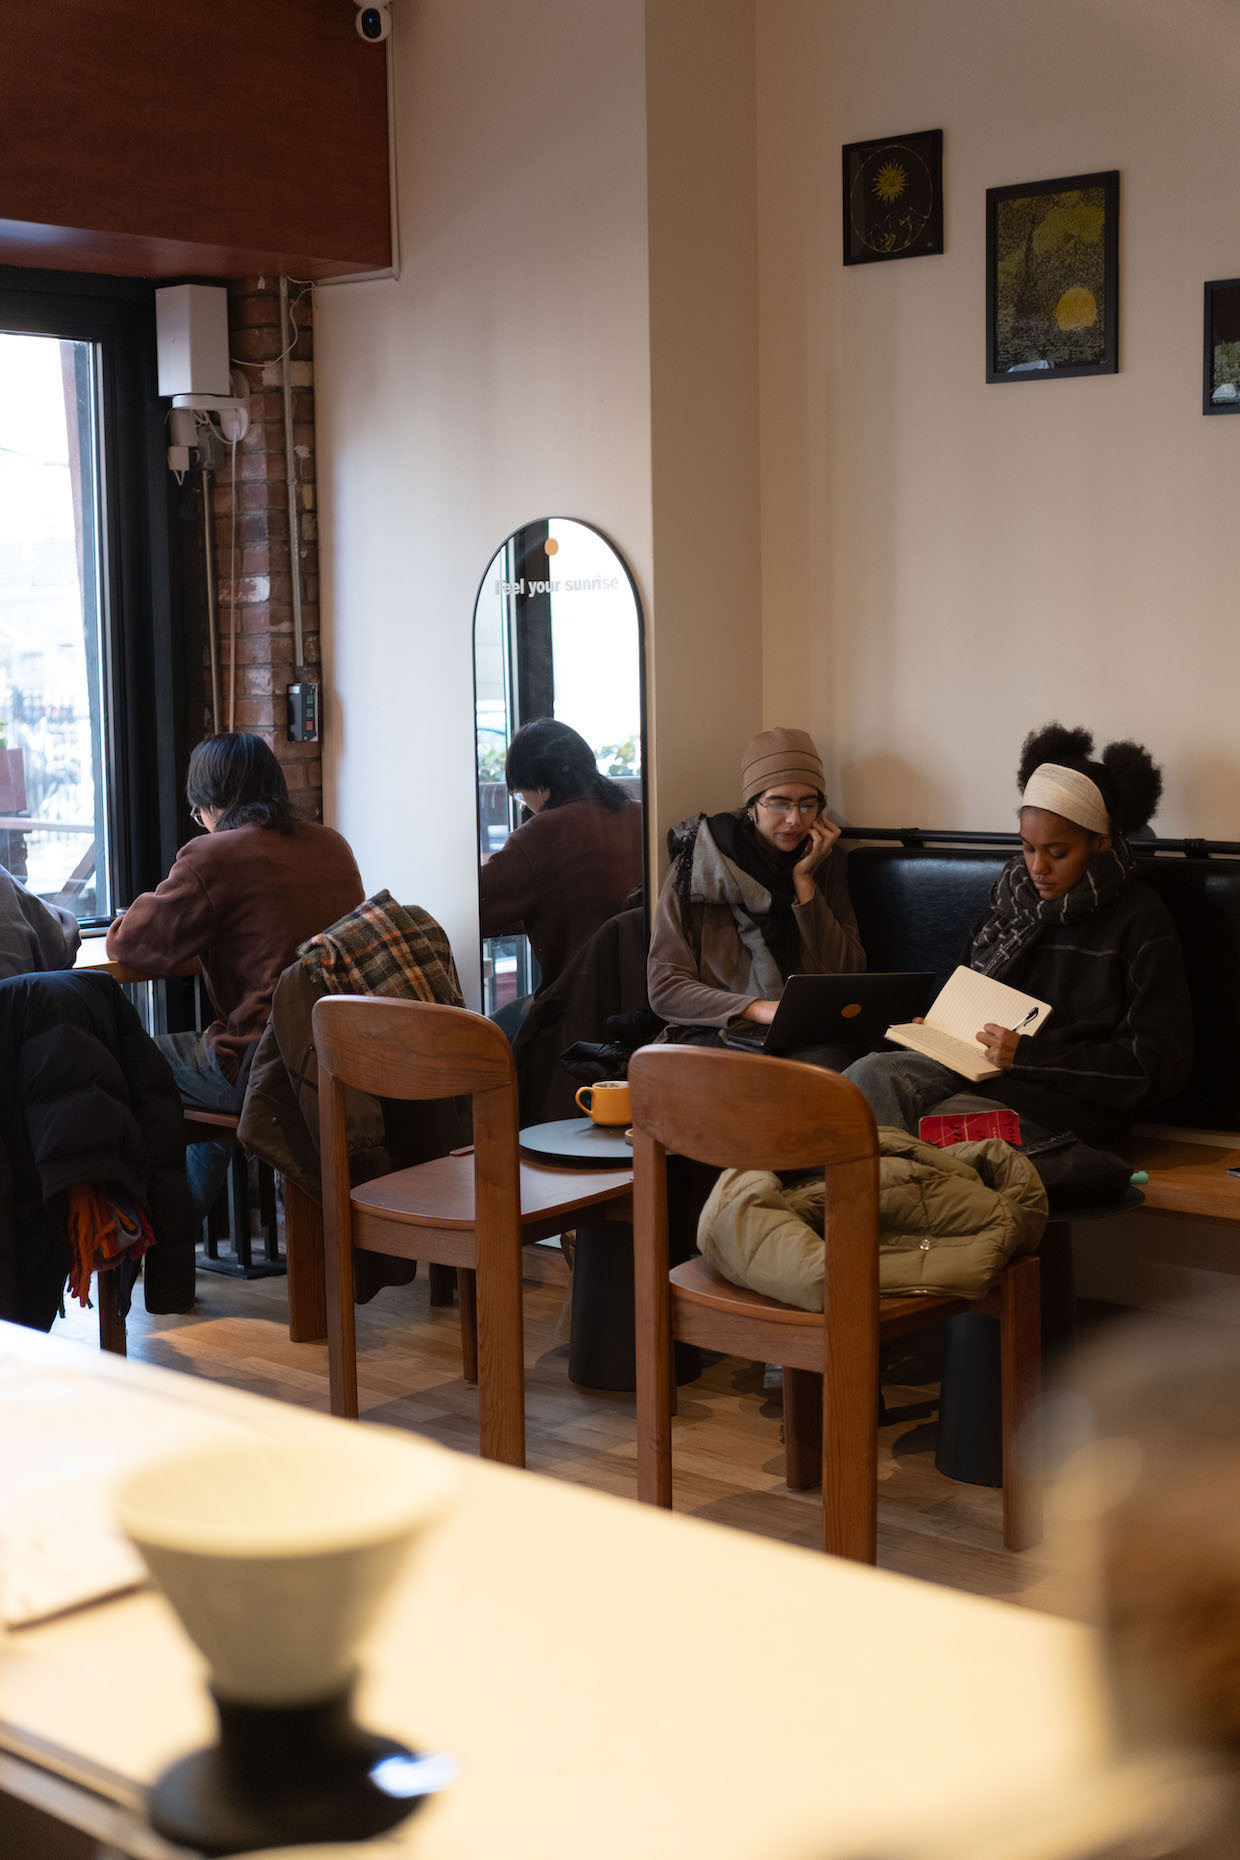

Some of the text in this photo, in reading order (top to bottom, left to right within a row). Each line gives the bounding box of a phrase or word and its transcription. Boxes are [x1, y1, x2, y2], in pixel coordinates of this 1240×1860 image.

[495, 575, 619, 598] Feel your sunrise
[1003, 1113, 1015, 1142] ooks
